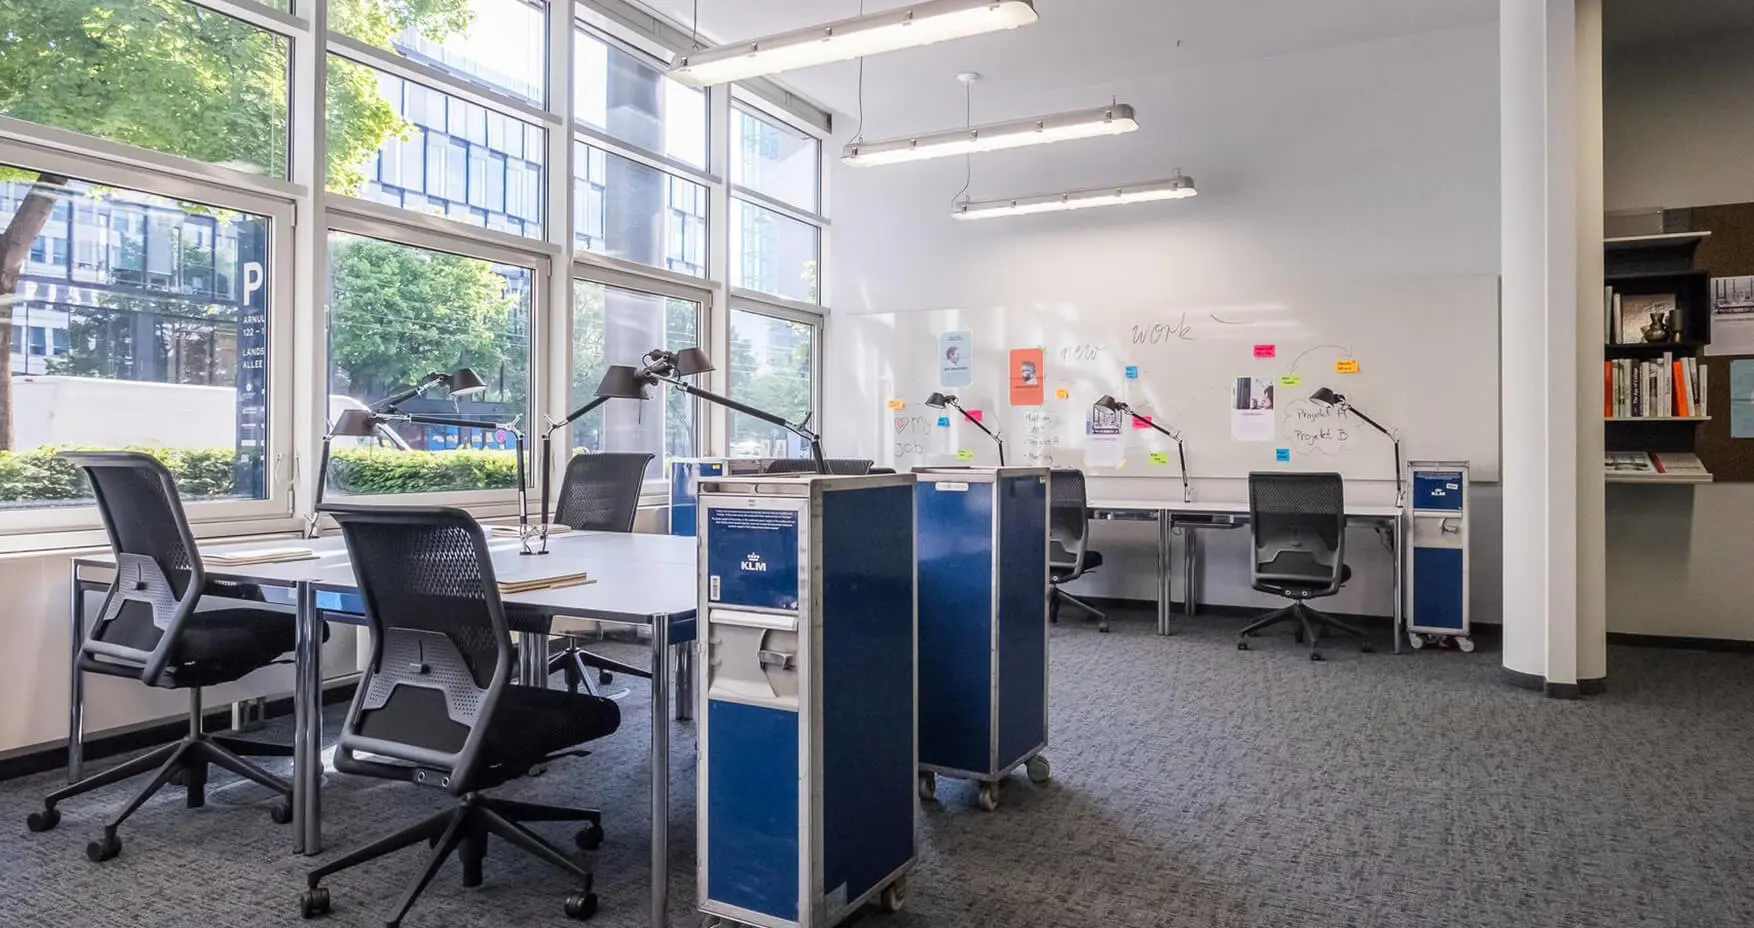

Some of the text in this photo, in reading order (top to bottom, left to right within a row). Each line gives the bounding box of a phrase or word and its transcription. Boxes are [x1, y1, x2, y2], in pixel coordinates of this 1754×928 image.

[244, 262, 263, 306] P
[1131, 311, 1192, 344] work
[1061, 344, 1105, 361] new
[243, 360, 262, 368] ALLEE
[1294, 428, 1349, 446] Projekt B
[895, 440, 923, 457] job
[741, 561, 767, 571] KLM
